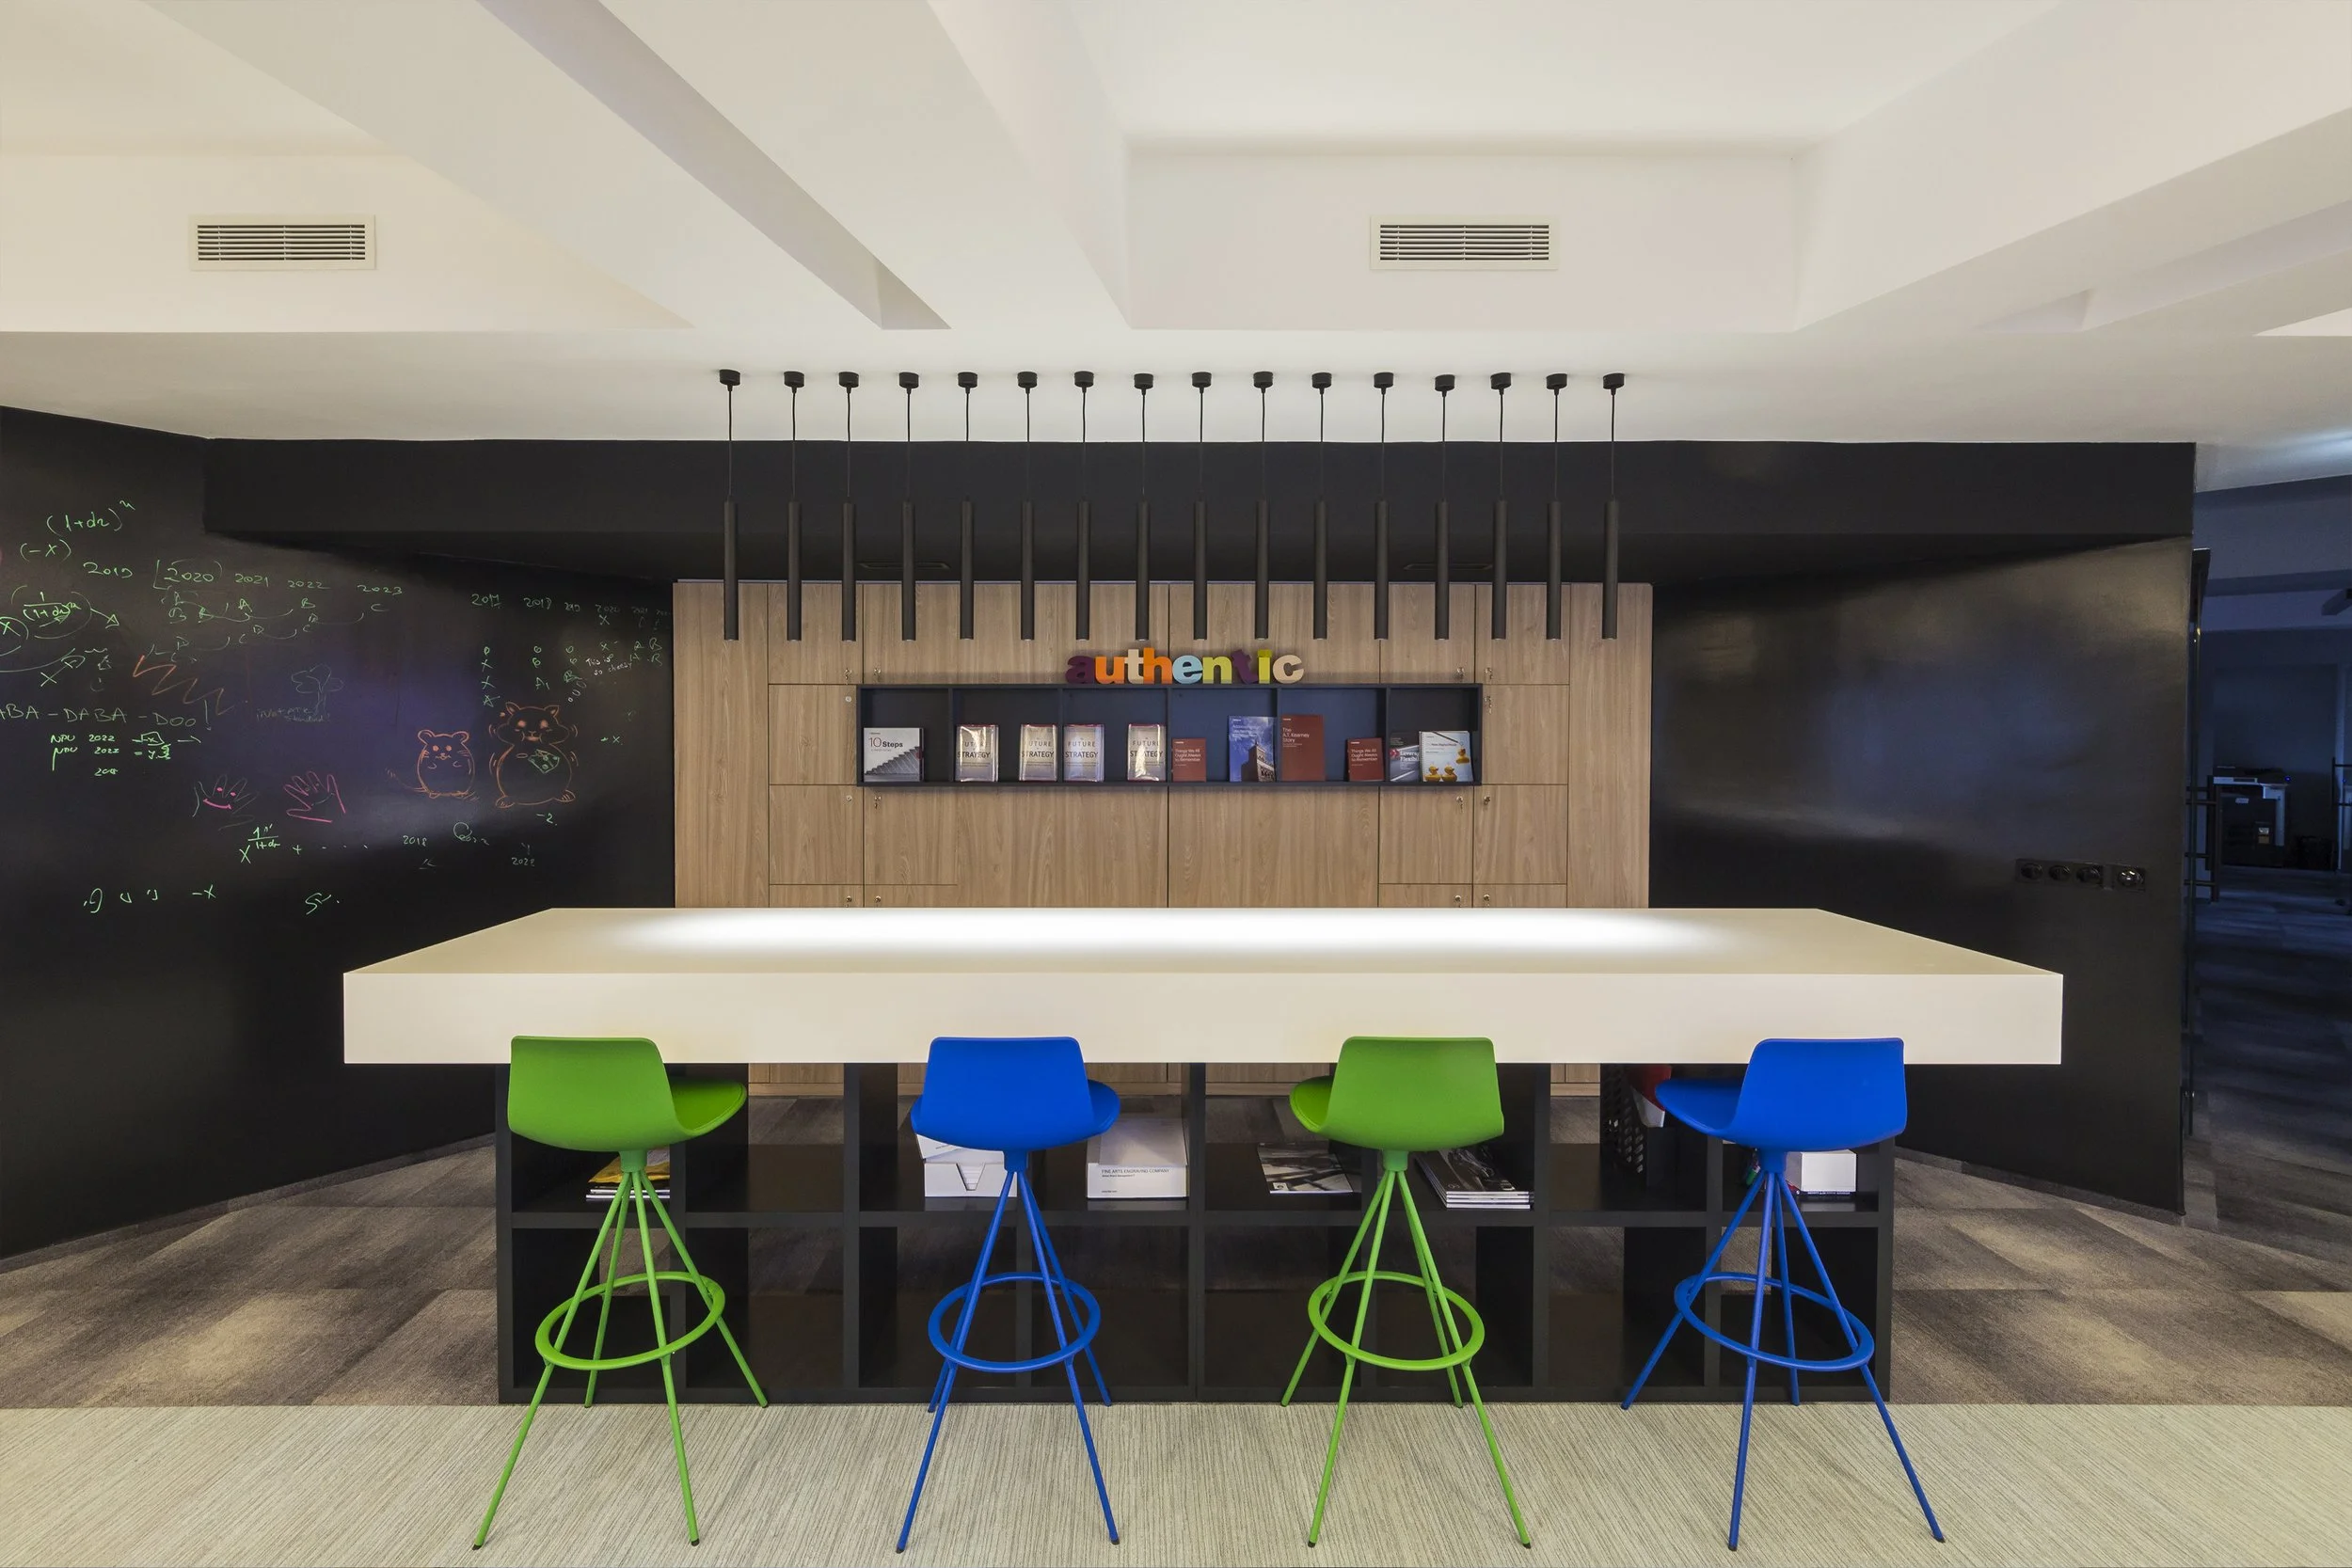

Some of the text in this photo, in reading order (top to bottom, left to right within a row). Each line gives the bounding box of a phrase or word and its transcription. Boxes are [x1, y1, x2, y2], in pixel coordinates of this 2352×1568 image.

[234, 574, 269, 588] 2021
[1064, 647, 1305, 685] authentic
[868, 736, 904, 751] 10 Steps
[1065, 750, 1099, 759] STRATEGY
